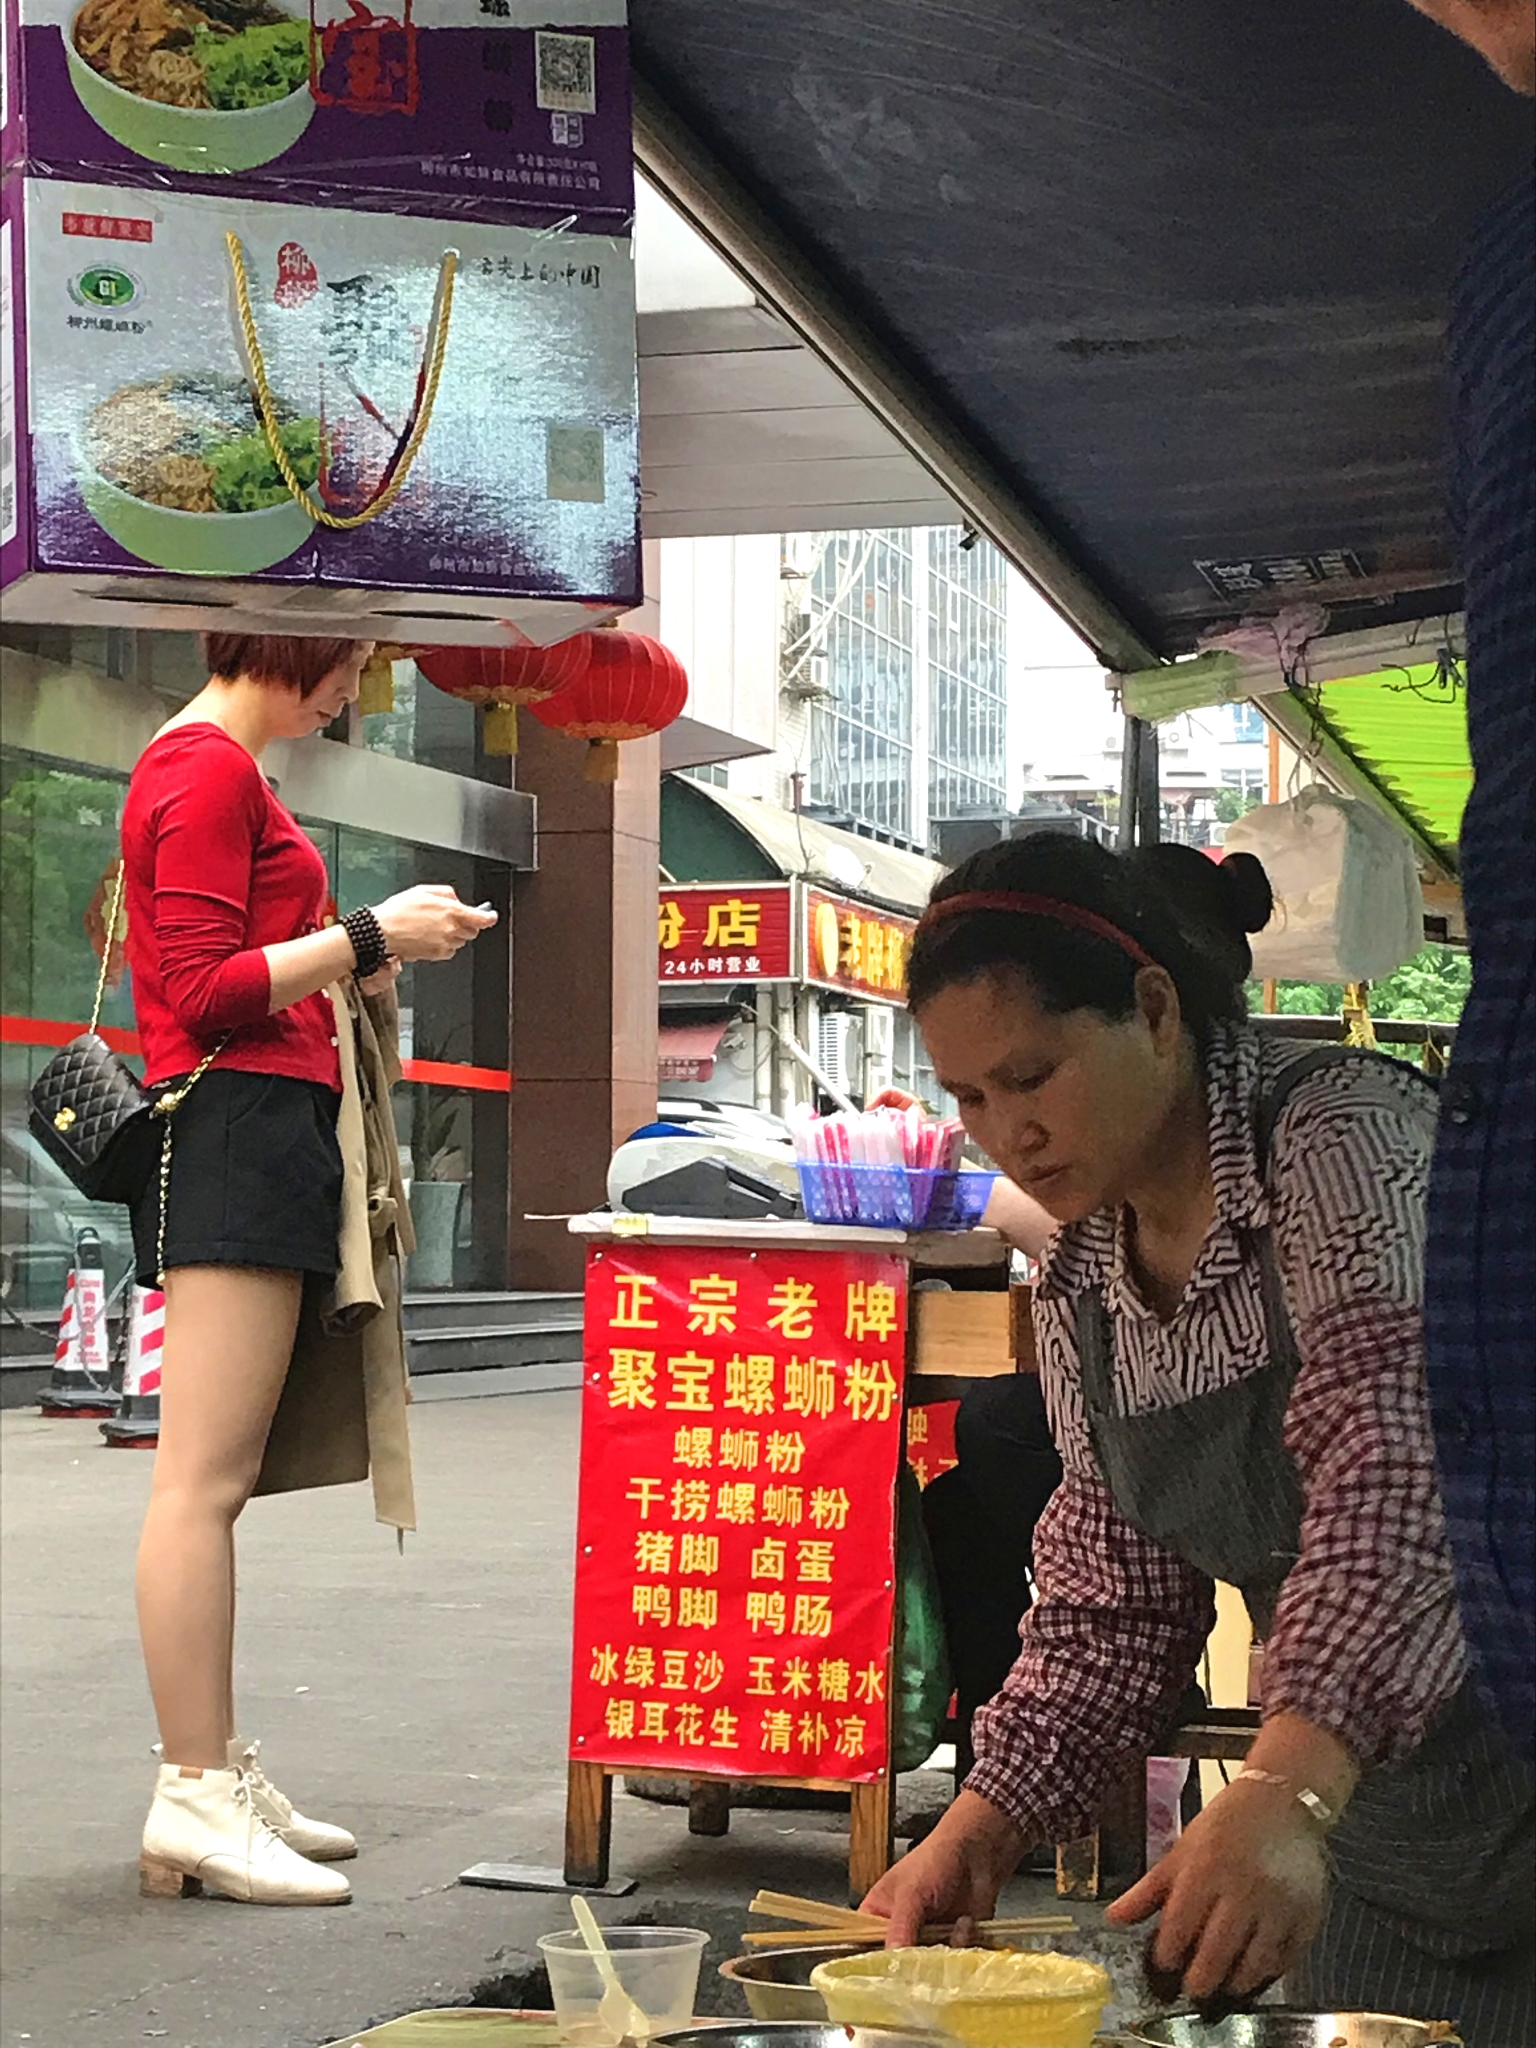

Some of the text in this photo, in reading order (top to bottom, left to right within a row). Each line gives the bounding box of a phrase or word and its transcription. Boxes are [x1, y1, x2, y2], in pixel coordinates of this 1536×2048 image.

[664, 956, 761, 975] 24小时营业
[608, 1273, 898, 1343] 正宗老牌
[607, 1347, 897, 1422] 聚宝螺蛳粉
[672, 1425, 806, 1474] 螺蛳粉
[625, 1477, 851, 1531] 干捞螺蛳粉
[633, 1531, 835, 1583] 猪脚 卤蛋
[631, 1584, 834, 1638] 鸭脚 鸭肠
[589, 1643, 886, 1705] 冰绿豆沙 玉米糖水
[604, 1697, 867, 1758] 银耳花生 清补凉
